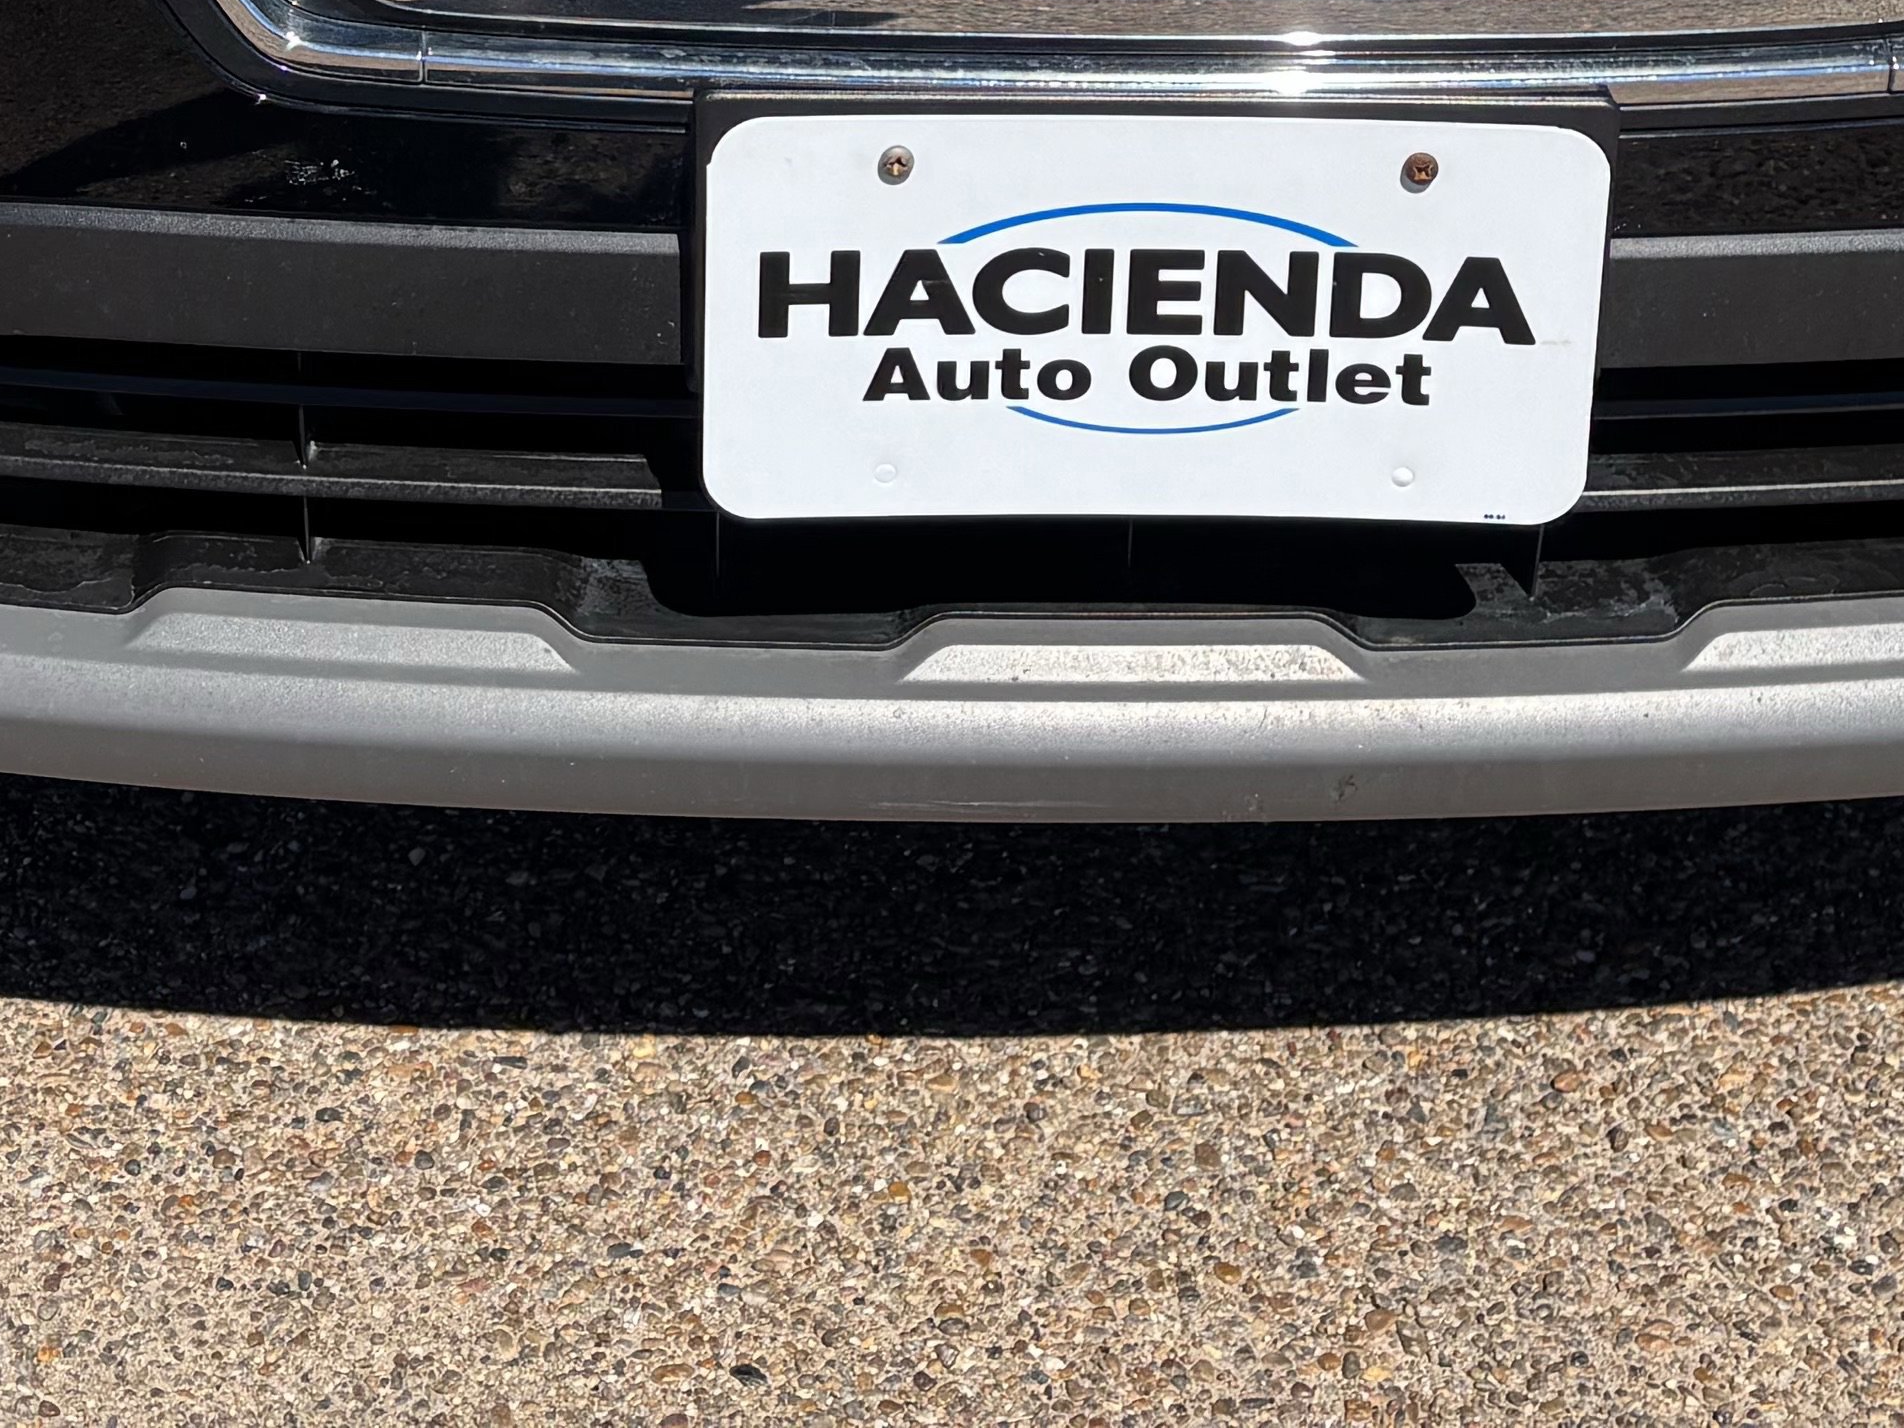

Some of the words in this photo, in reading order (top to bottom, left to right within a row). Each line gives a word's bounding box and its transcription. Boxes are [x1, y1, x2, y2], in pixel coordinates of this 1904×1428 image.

[757, 247, 1536, 346] HACIENDA
[862, 347, 1092, 402] Auto
[1128, 345, 1432, 407] Outlet
